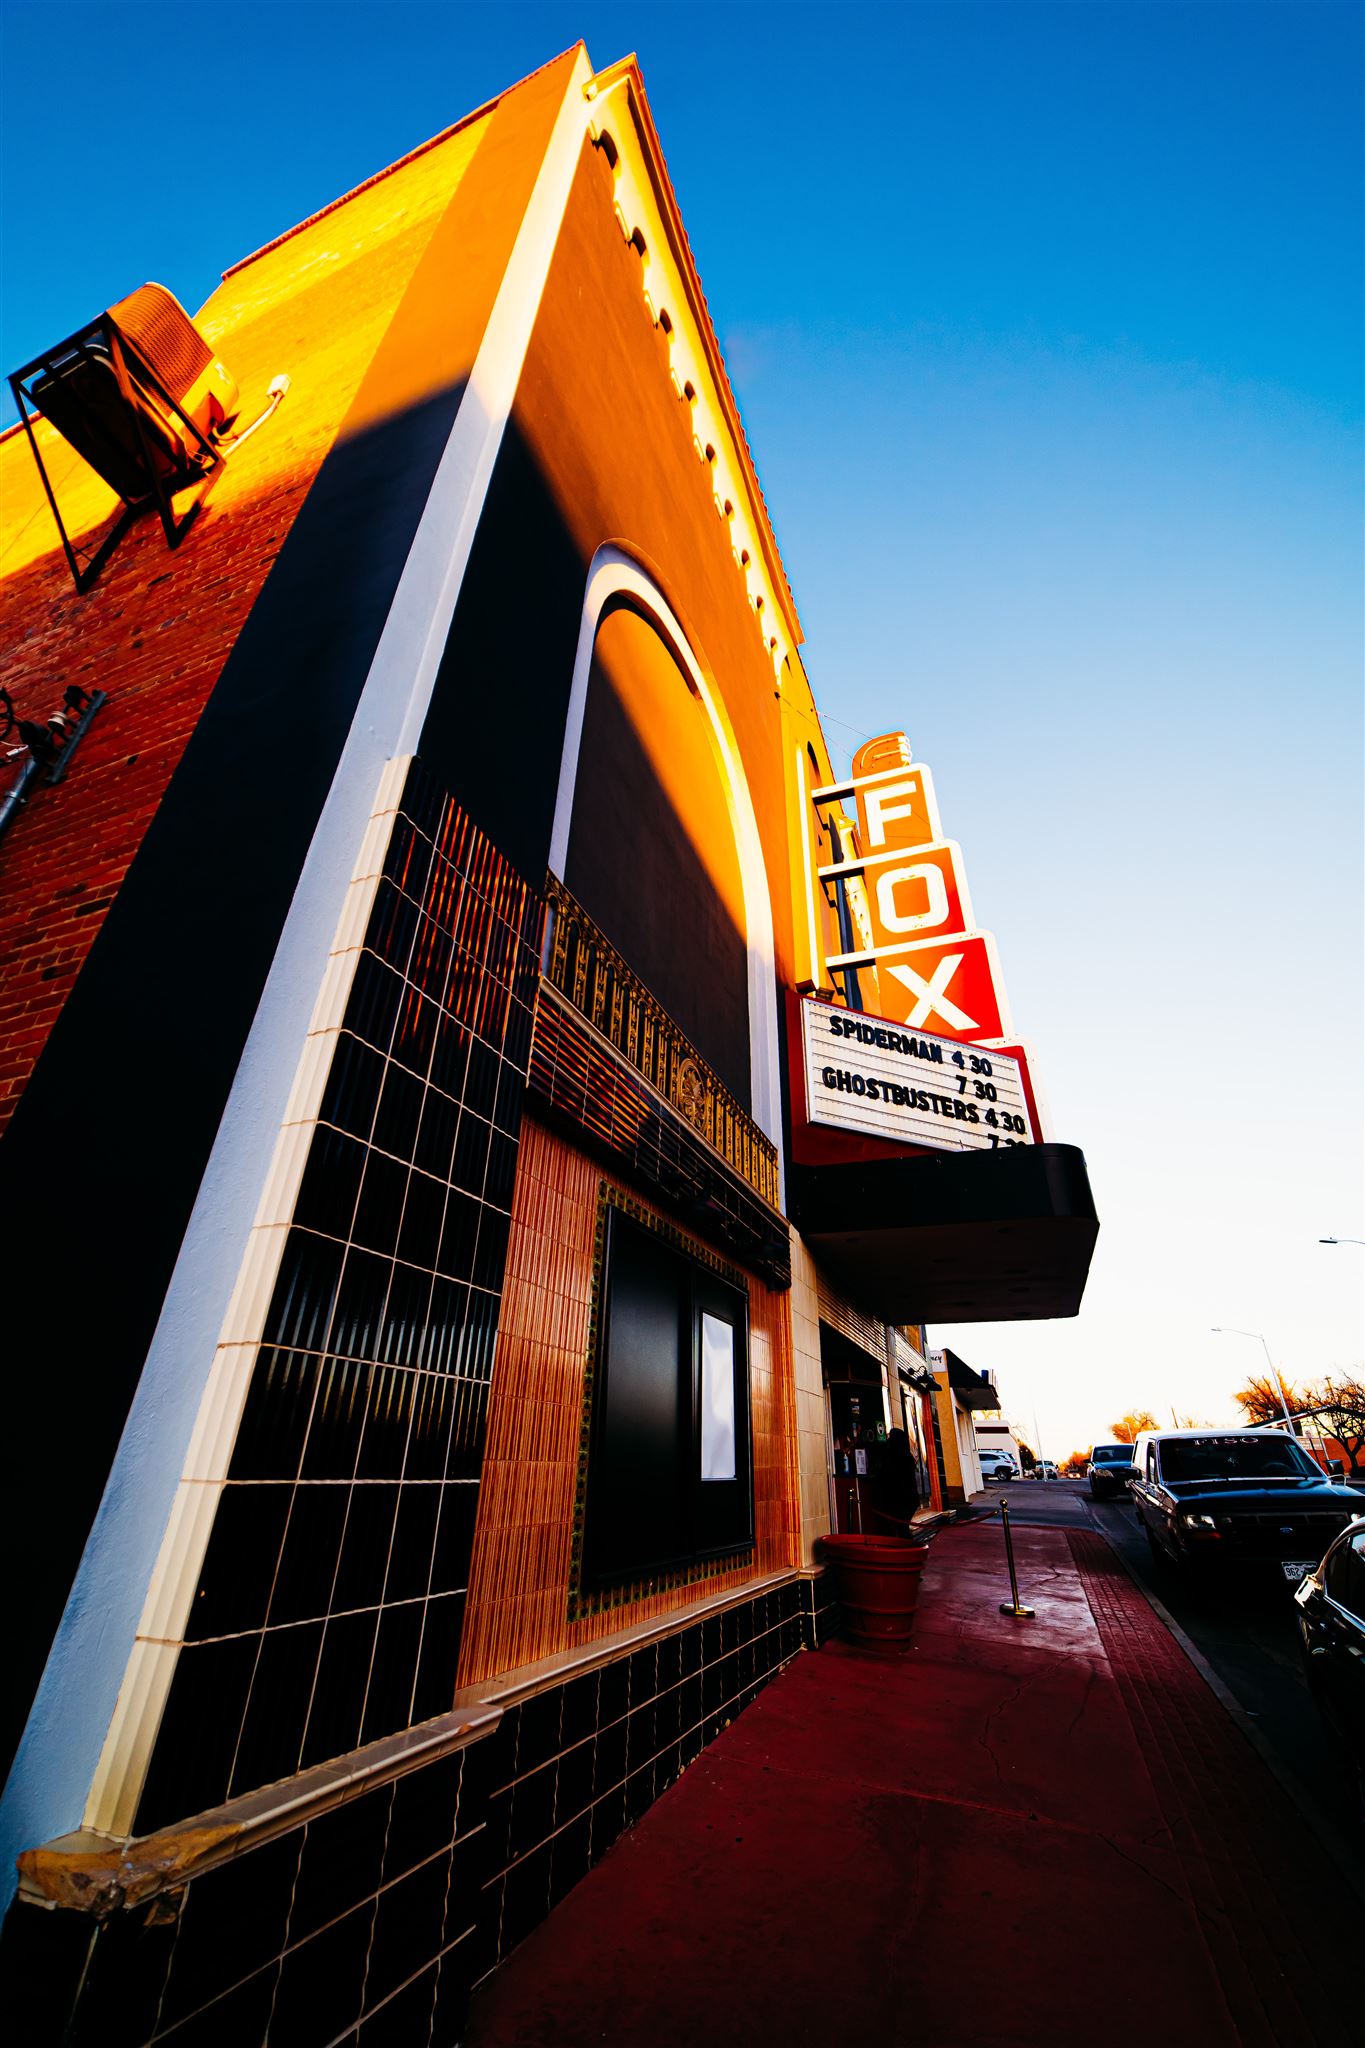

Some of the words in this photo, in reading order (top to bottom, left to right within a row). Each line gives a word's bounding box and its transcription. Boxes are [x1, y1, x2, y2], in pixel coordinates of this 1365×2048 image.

[863, 780, 981, 1030] FOX
[829, 1015, 943, 1064] SPIDERMAN
[951, 1050, 965, 1070] 4
[969, 1054, 993, 1077] 30
[822, 1066, 980, 1124] GHOSTBUSTERS
[985, 1107, 999, 1129] 4
[1001, 1111, 1026, 1135] 30
[956, 1074, 967, 1095] 7
[973, 1080, 997, 1102] 30
